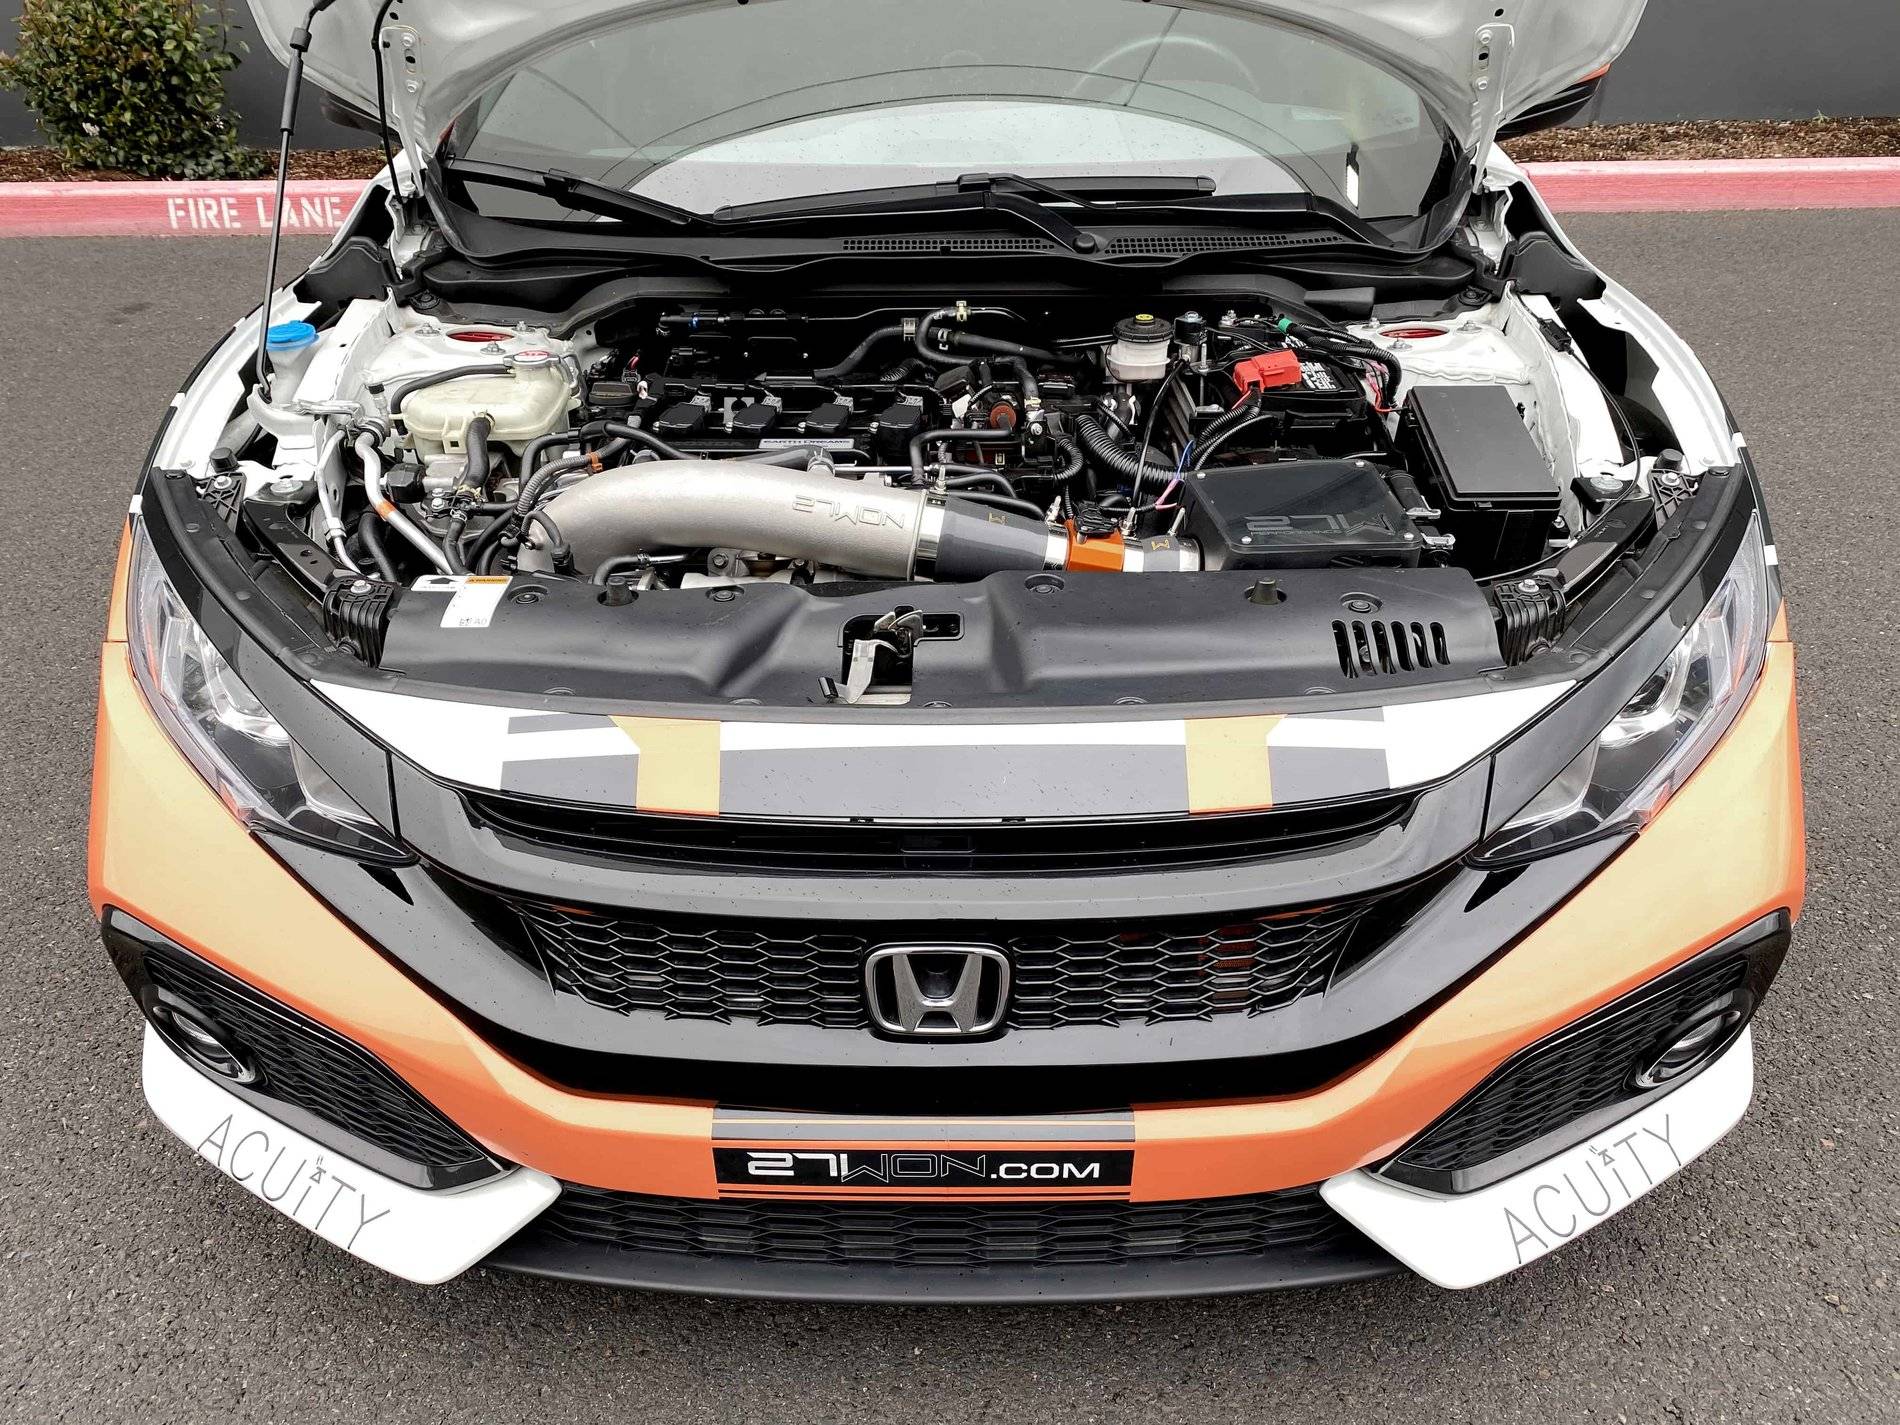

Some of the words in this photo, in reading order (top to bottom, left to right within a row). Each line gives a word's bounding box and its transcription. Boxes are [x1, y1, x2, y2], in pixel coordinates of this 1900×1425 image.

[167, 197, 241, 229] FIRE
[256, 197, 345, 228] LANE
[197, 1114, 391, 1250] ACUITY
[1504, 1114, 1682, 1265] ACUITY
